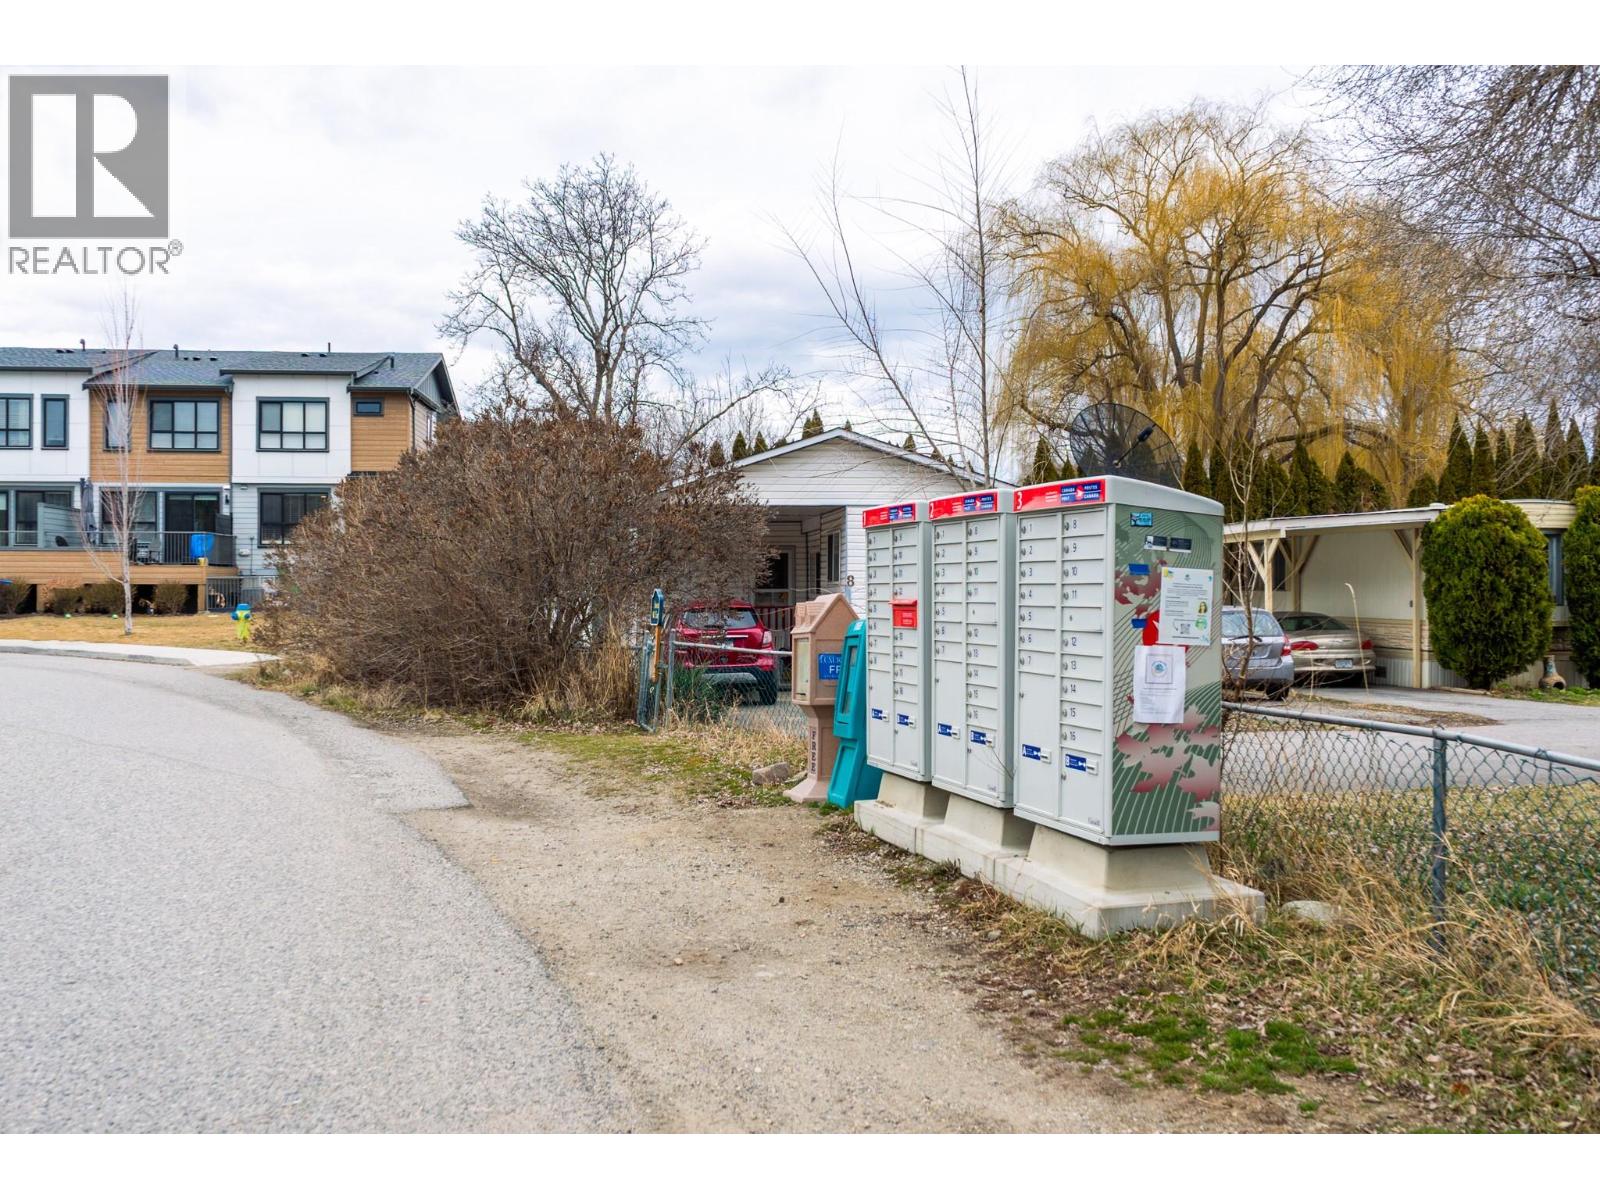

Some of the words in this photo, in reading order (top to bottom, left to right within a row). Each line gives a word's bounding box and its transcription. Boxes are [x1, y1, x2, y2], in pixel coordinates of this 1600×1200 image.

[1016, 491, 1023, 510] 3
[929, 502, 935, 518] 2
[846, 575, 855, 587] 8
